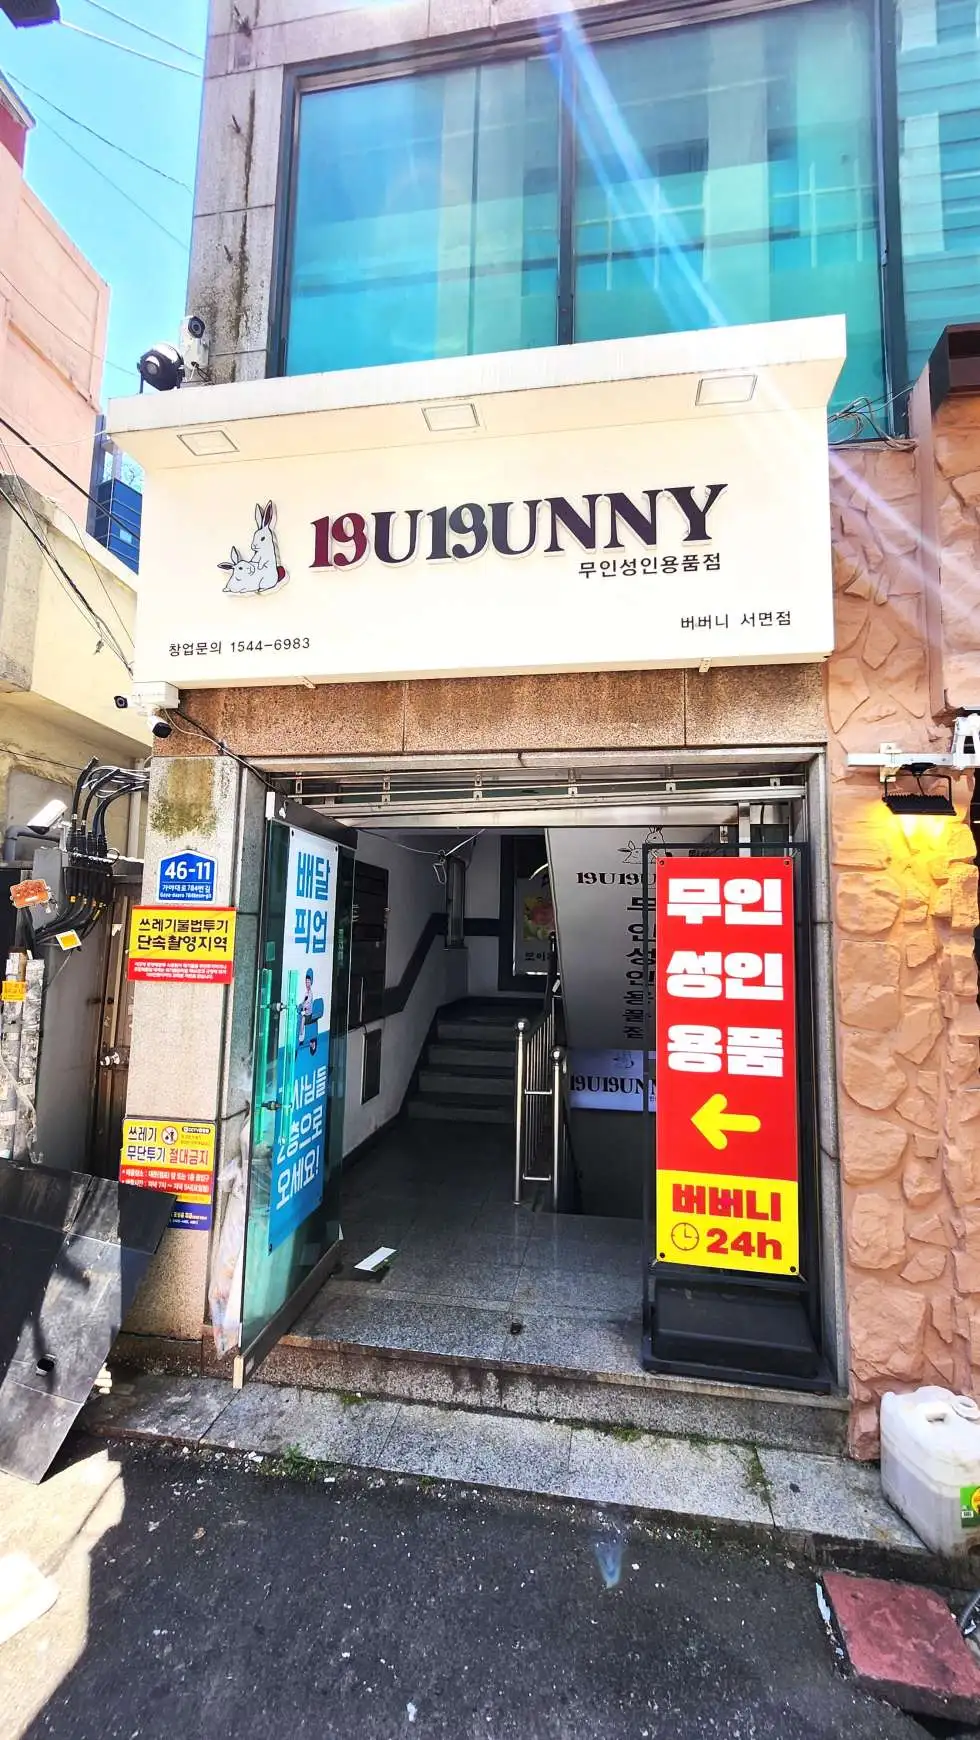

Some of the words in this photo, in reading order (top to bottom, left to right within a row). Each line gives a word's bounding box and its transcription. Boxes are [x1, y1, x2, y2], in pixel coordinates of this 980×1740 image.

[578, 553, 722, 579] 무인성인용품점
[681, 613, 729, 631] 버버니
[740, 610, 792, 628] 서면점
[168, 641, 222, 657] 창업문의
[230, 637, 311, 653] 1544-6983
[164, 861, 211, 880] 46-11
[296, 851, 330, 901] 배달
[667, 878, 783, 926] 무인
[138, 918, 229, 933] 쓰레기불법투기
[137, 935, 228, 952] 단속촬영지역
[666, 950, 784, 1001] 성인
[667, 1024, 784, 1077] 용품
[128, 1126, 157, 1142] 쓰레기
[127, 1145, 166, 1163] 무단투기
[169, 1148, 209, 1166] 절대금지
[276, 1144, 321, 1210] 오세요!
[672, 1183, 781, 1222] 버버니
[706, 1227, 782, 1260] 24h
